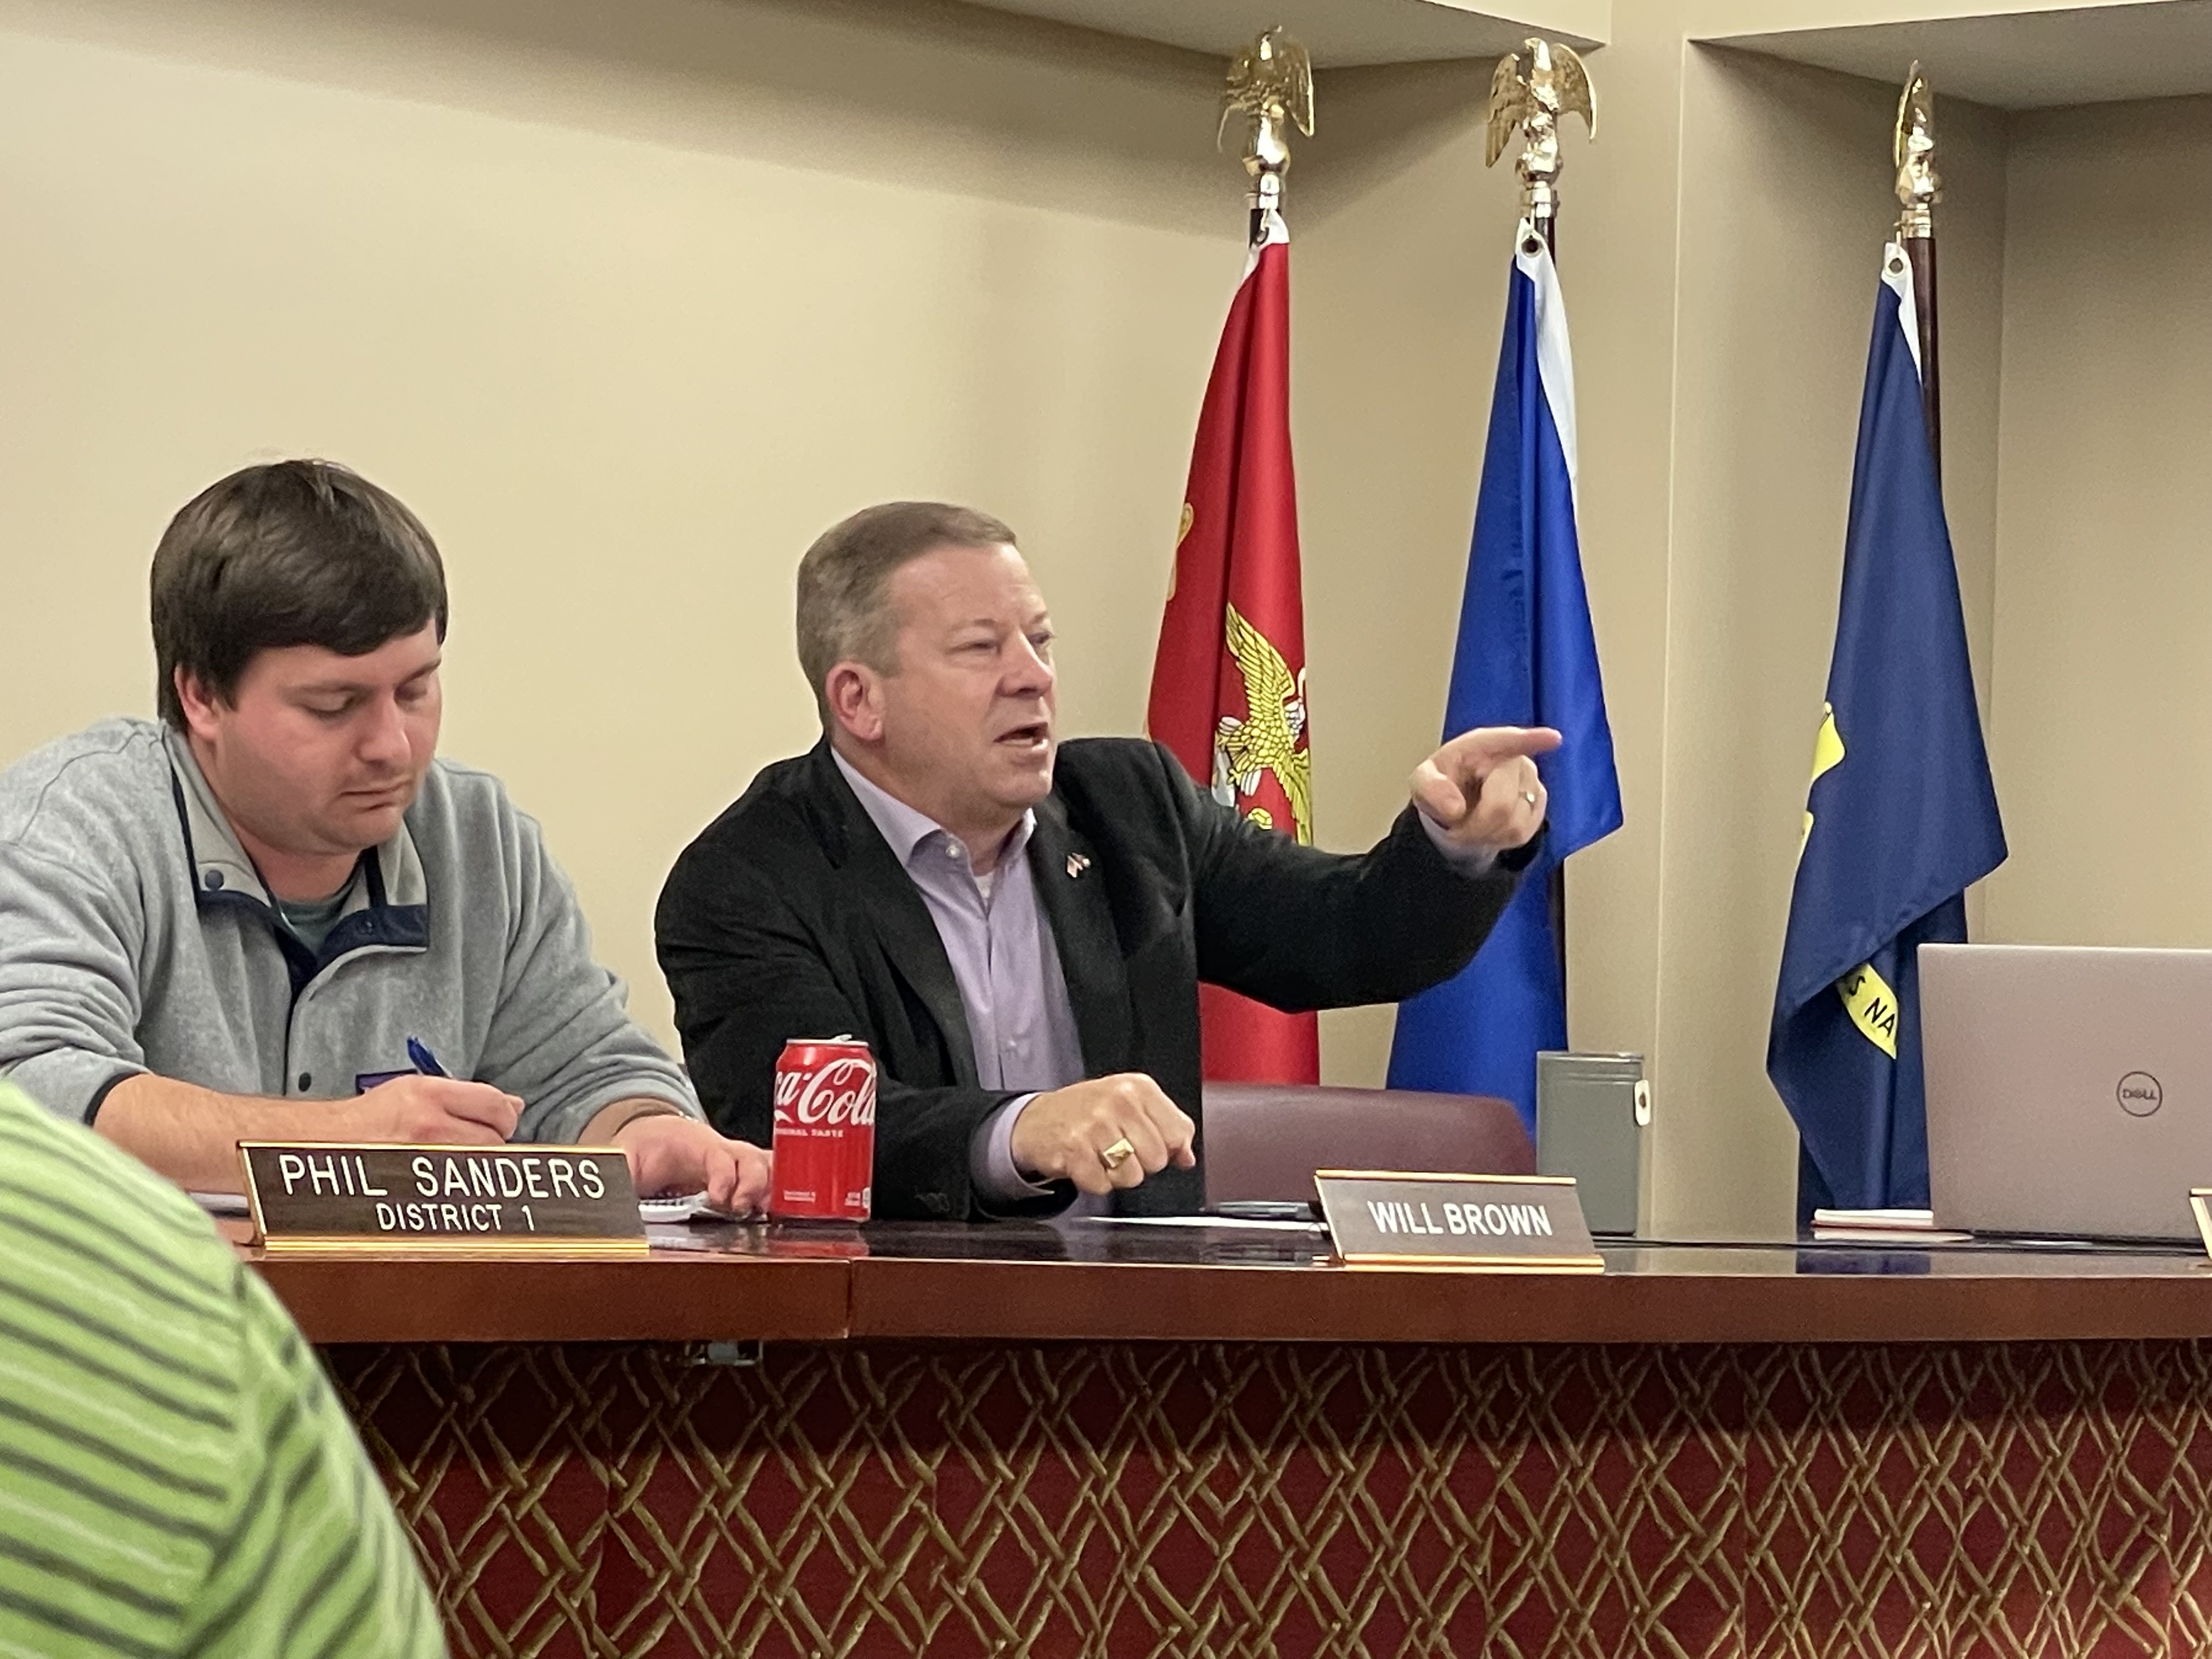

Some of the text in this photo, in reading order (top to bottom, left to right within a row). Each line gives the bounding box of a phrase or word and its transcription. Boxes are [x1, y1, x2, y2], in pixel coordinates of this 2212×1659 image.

[2122, 1088, 2158, 1101] DELL
[279, 1154, 605, 1199] PHIL SANDERS
[375, 1203, 535, 1231] DISTRICT 1
[1367, 1200, 1553, 1236] WILL BROWN
